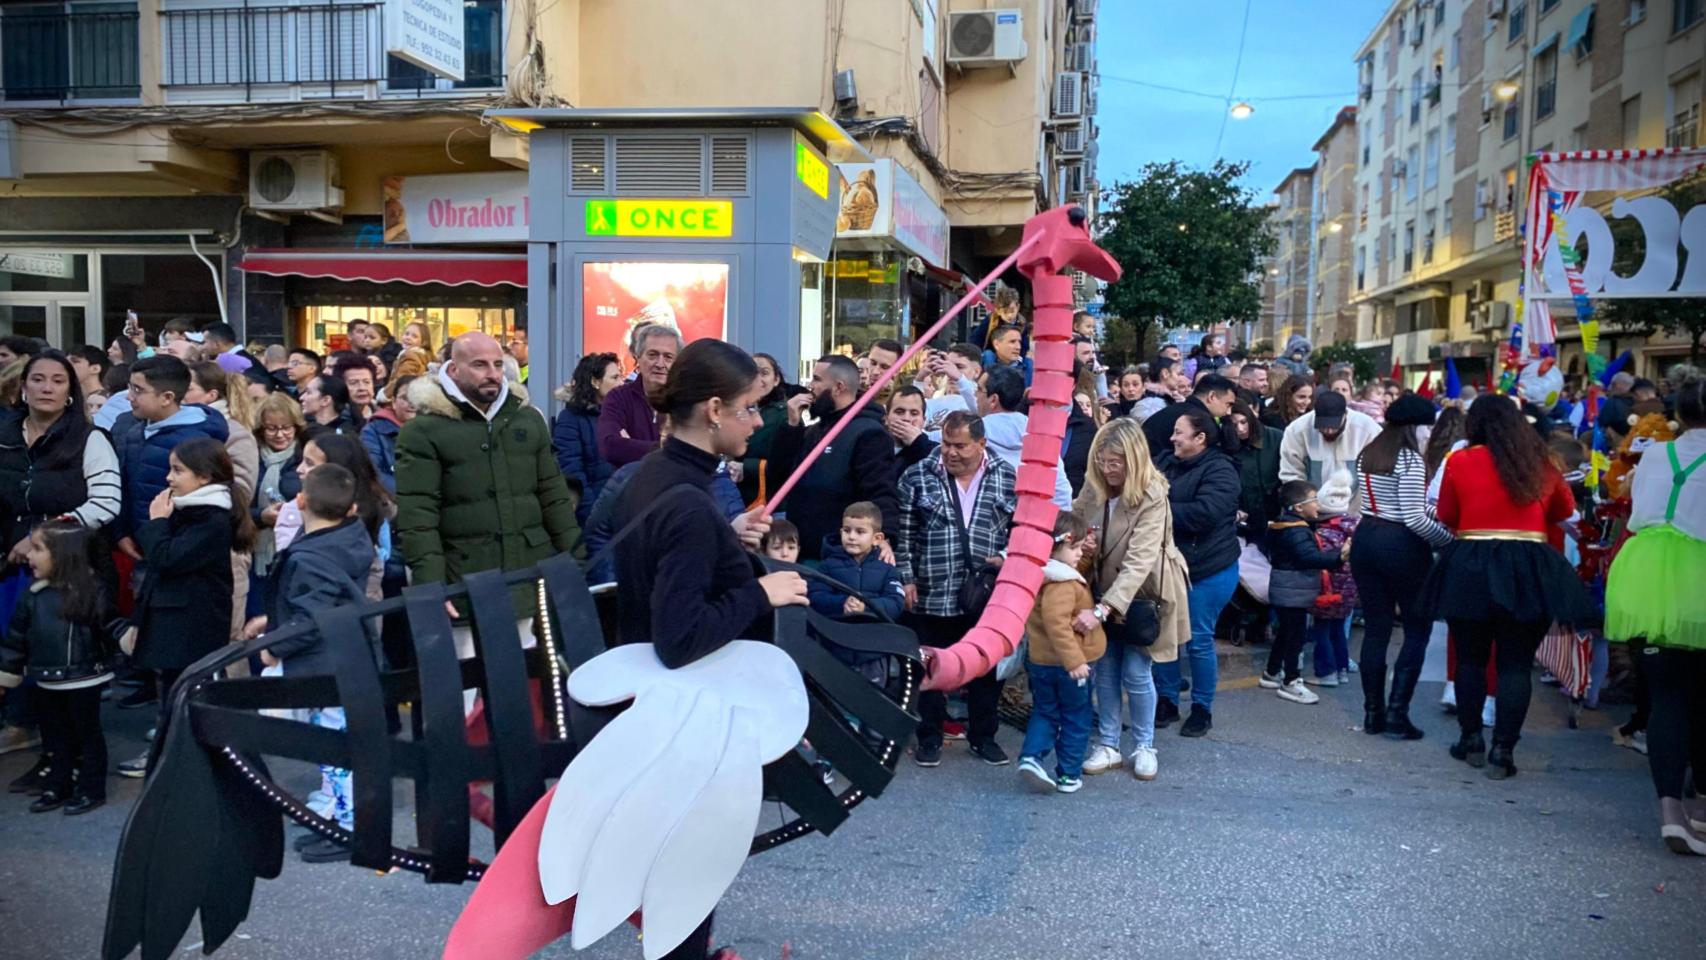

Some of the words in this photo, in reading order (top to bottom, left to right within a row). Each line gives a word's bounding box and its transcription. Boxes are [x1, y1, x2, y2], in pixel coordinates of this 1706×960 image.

[421, 42, 432, 57] 952
[428, 24, 437, 37] DE
[437, 29, 462, 51] ESTUDIO
[428, 196, 516, 228] Obrador
[630, 207, 720, 229] ONCE
